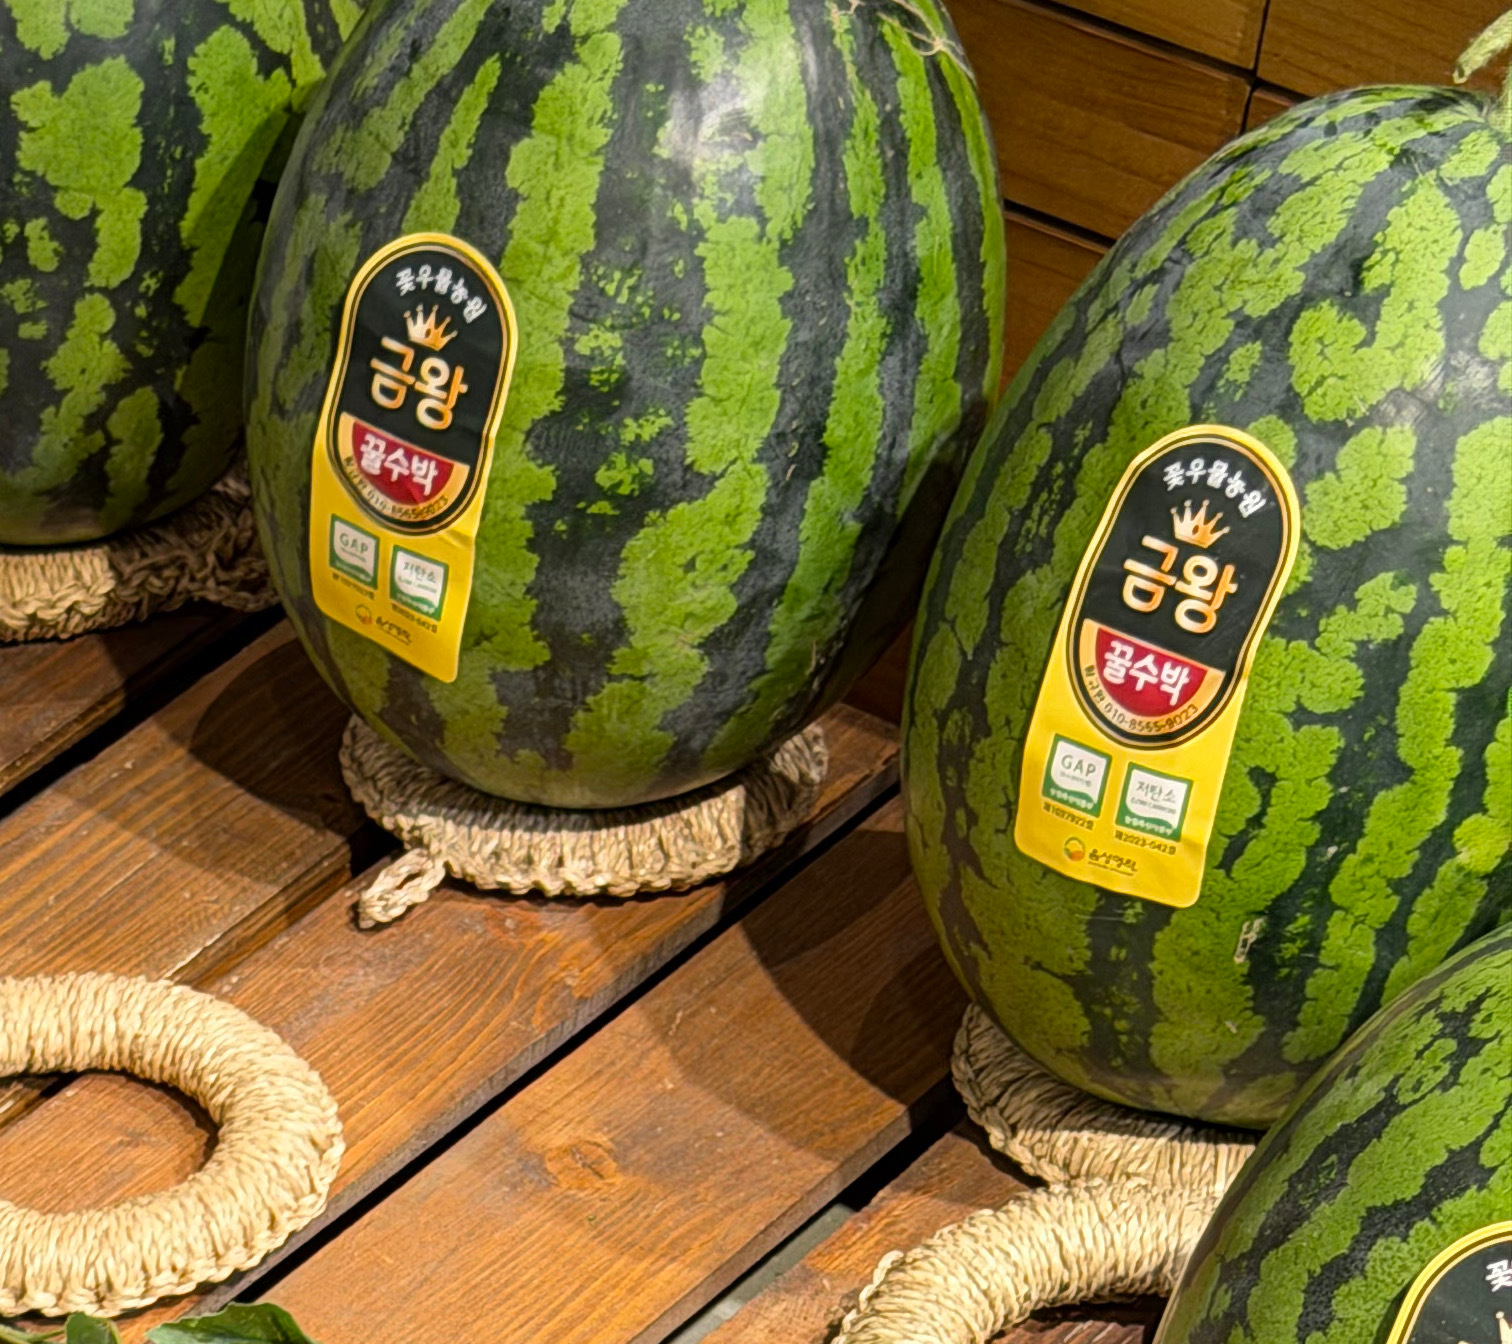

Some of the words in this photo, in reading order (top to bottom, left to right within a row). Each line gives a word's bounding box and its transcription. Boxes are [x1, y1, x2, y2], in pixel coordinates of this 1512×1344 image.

[370, 335, 467, 430] 금왕
[360, 432, 438, 496] 꿀수박
[339, 532, 369, 555] GAP
[1122, 534, 1238, 633] 금왕
[1103, 639, 1190, 706] 꿀수박
[1061, 754, 1096, 777] GAP
[1136, 779, 1176, 805] 저탄소
